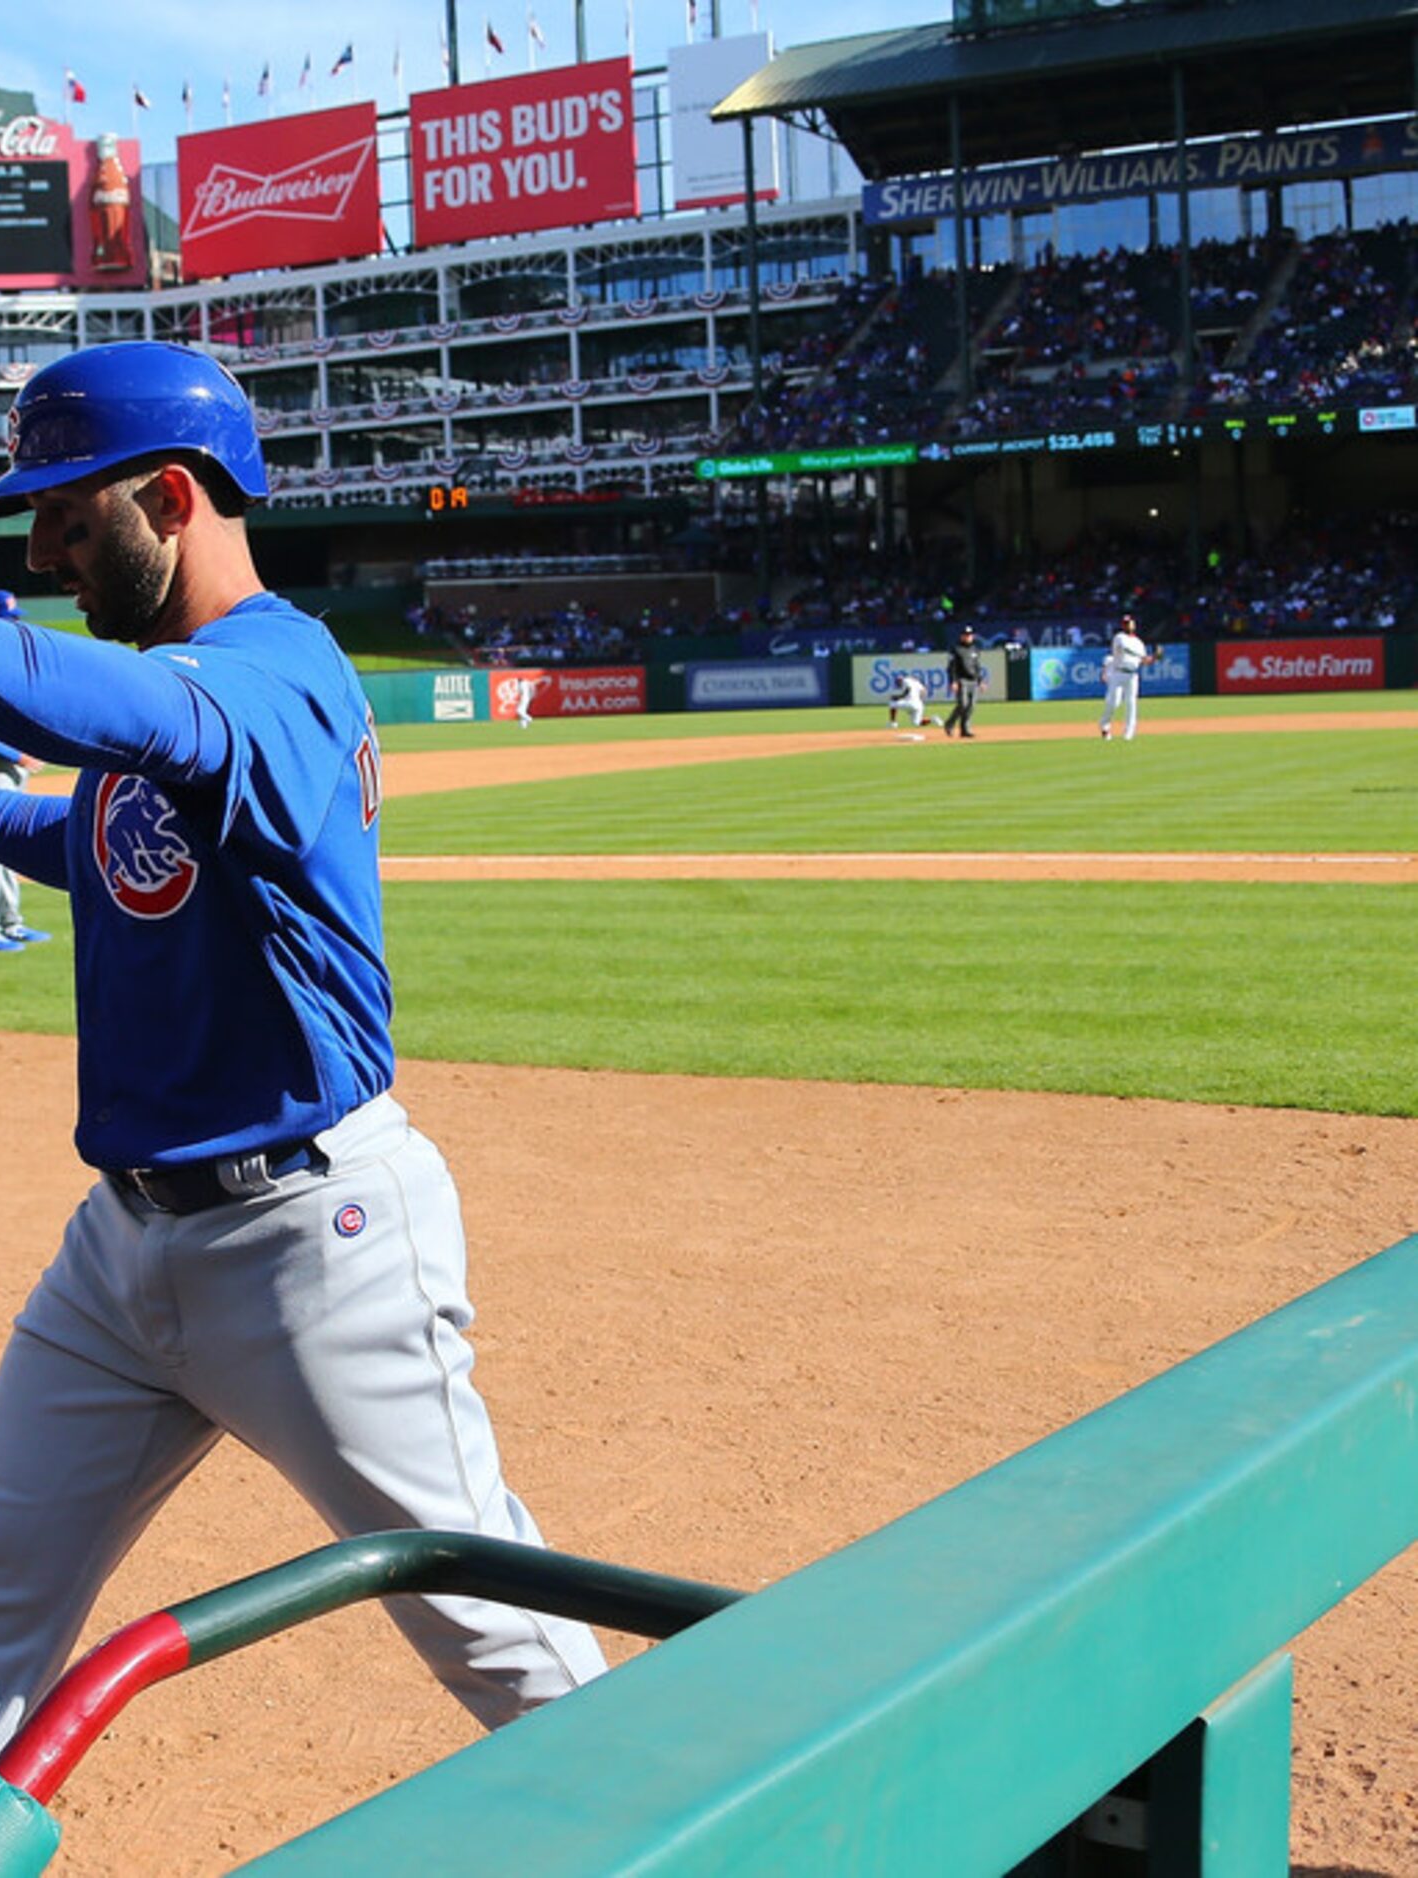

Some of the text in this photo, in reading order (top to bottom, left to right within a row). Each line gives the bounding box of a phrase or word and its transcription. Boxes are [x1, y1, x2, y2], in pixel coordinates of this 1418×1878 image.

[420, 89, 624, 161] THIS BUD'S
[1216, 134, 1341, 179] PAINTS
[195, 171, 355, 219] Budweiser
[424, 149, 588, 211] FOR YOU.
[559, 676, 638, 691] Insurance
[869, 658, 992, 698] Snap
[562, 695, 640, 711] AAA.com
